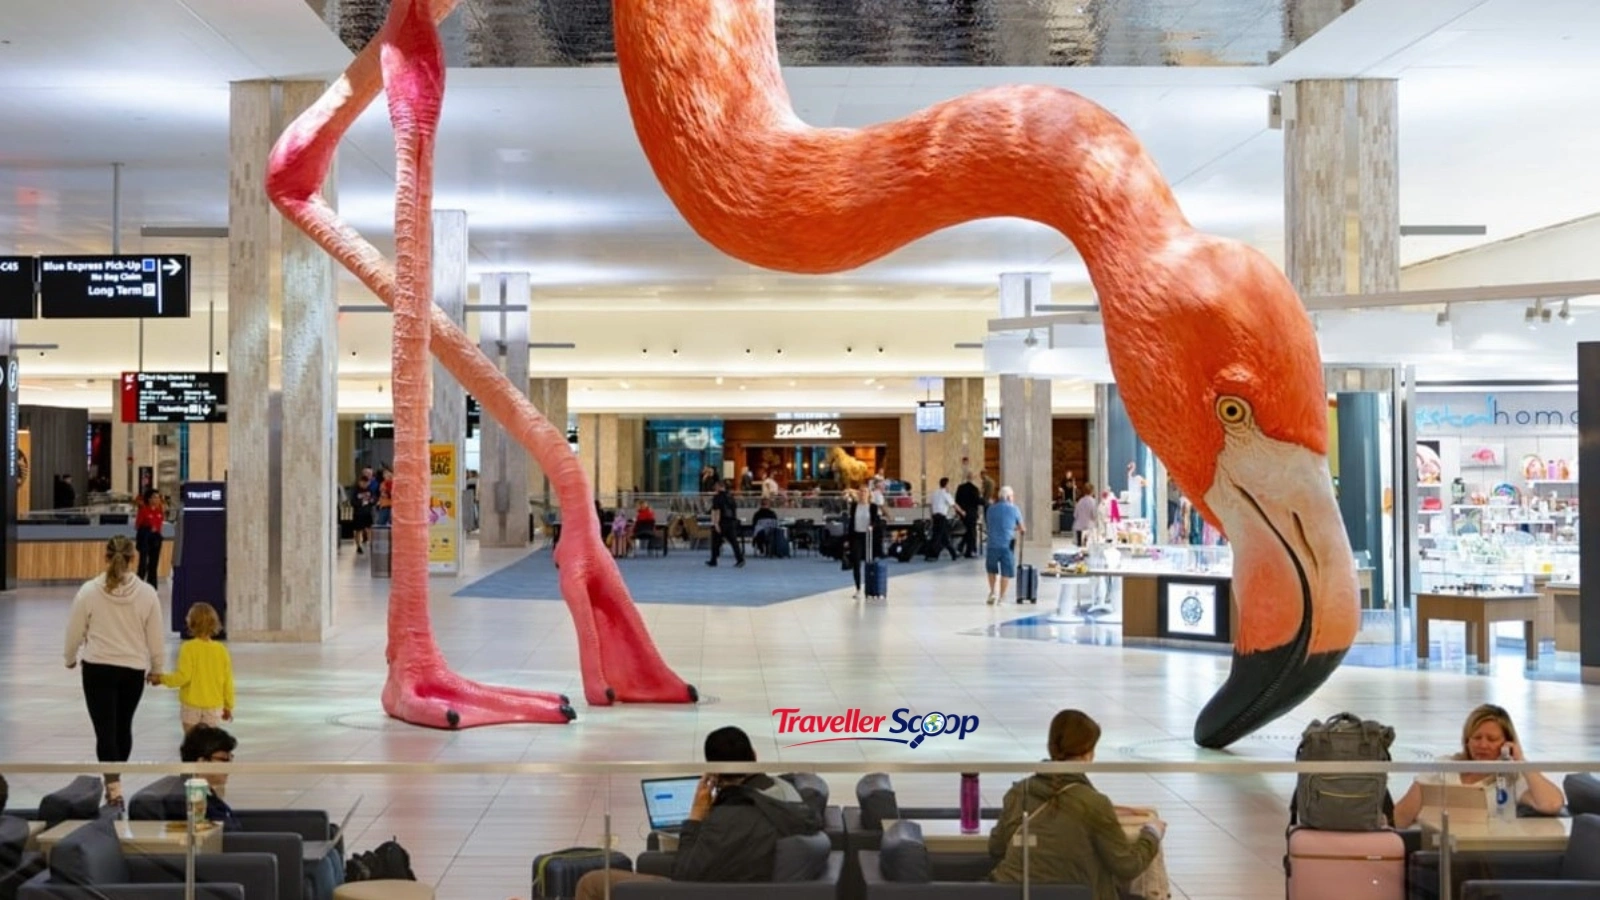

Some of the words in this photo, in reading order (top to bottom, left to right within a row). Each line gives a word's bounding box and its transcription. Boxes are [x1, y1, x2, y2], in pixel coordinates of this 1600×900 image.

[43, 261, 64, 271] Blue
[67, 261, 103, 273] Express
[105, 260, 141, 273] Pick-Up
[91, 273, 103, 281] No
[104, 273, 119, 282] Bag
[120, 273, 142, 281] Claim
[88, 285, 114, 298] Long
[116, 285, 142, 296] Term
[158, 405, 189, 414] Ticketing
